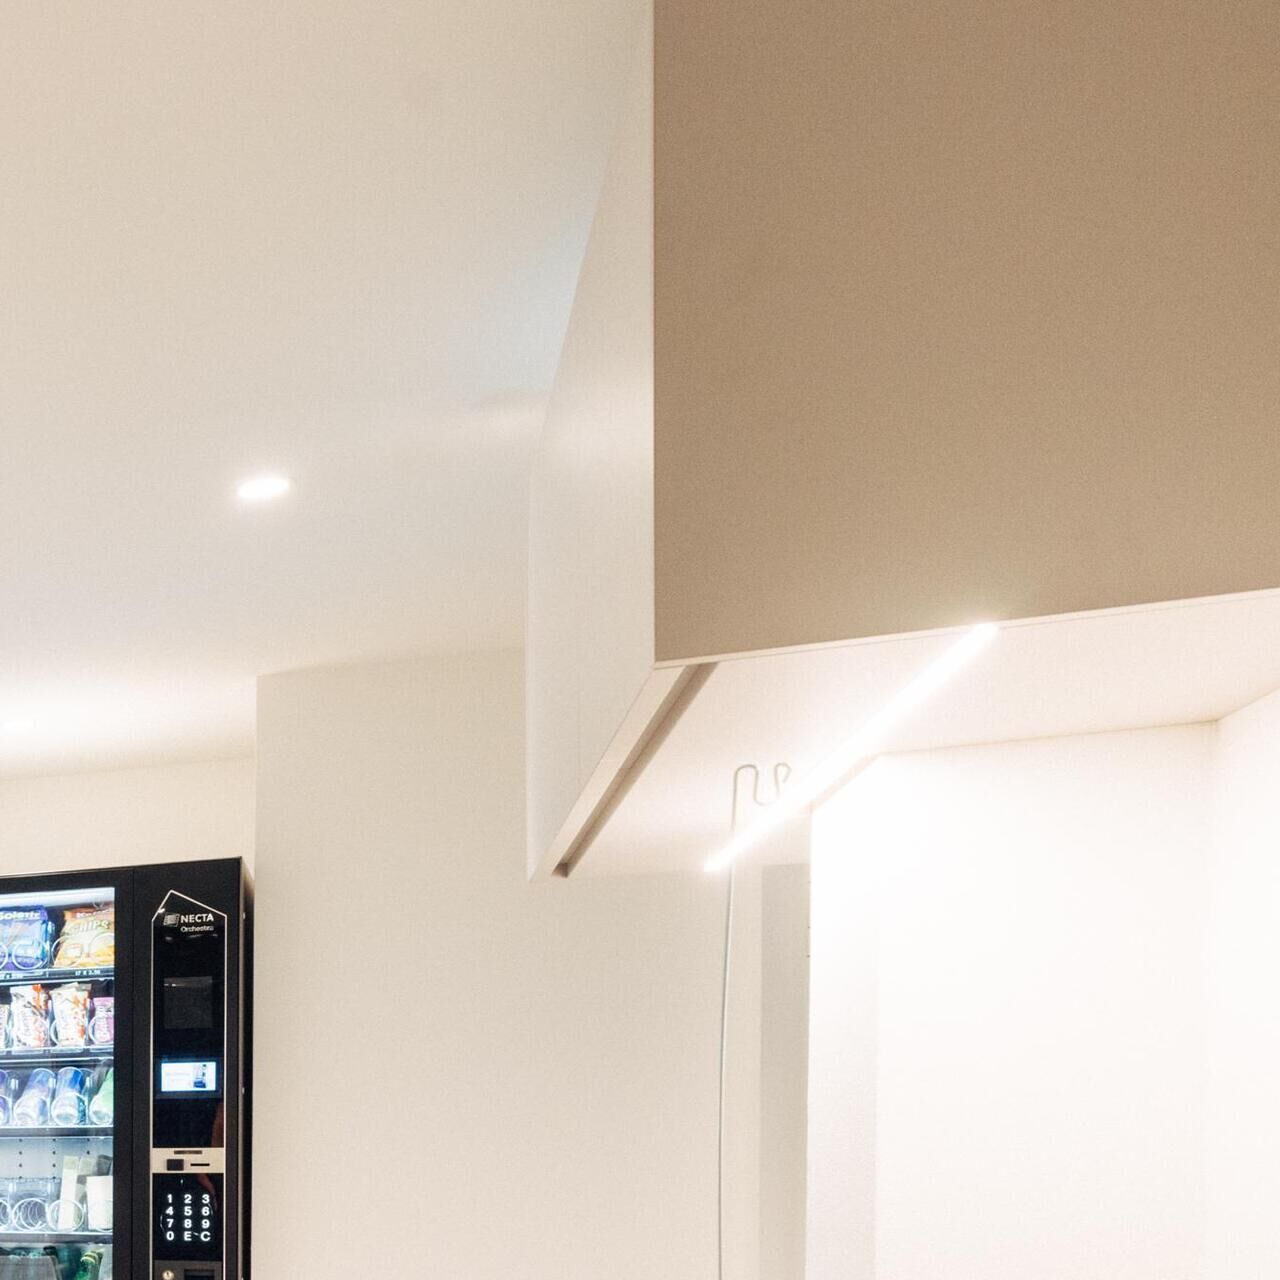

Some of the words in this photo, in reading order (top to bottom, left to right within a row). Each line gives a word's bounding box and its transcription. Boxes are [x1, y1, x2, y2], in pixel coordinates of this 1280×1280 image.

[180, 913, 214, 924] NECTA
[167, 1194, 173, 1204] 1
[184, 1194, 192, 1204] 2
[201, 1194, 210, 1204] 3
[165, 1206, 174, 1216] 4
[184, 1206, 192, 1216] 5
[201, 1206, 210, 1216] 6
[166, 1219, 174, 1229] 7
[184, 1219, 192, 1229] 8
[201, 1219, 210, 1229] 9
[166, 1231, 174, 1241] 0
[184, 1231, 192, 1241] E
[200, 1231, 211, 1241] C
